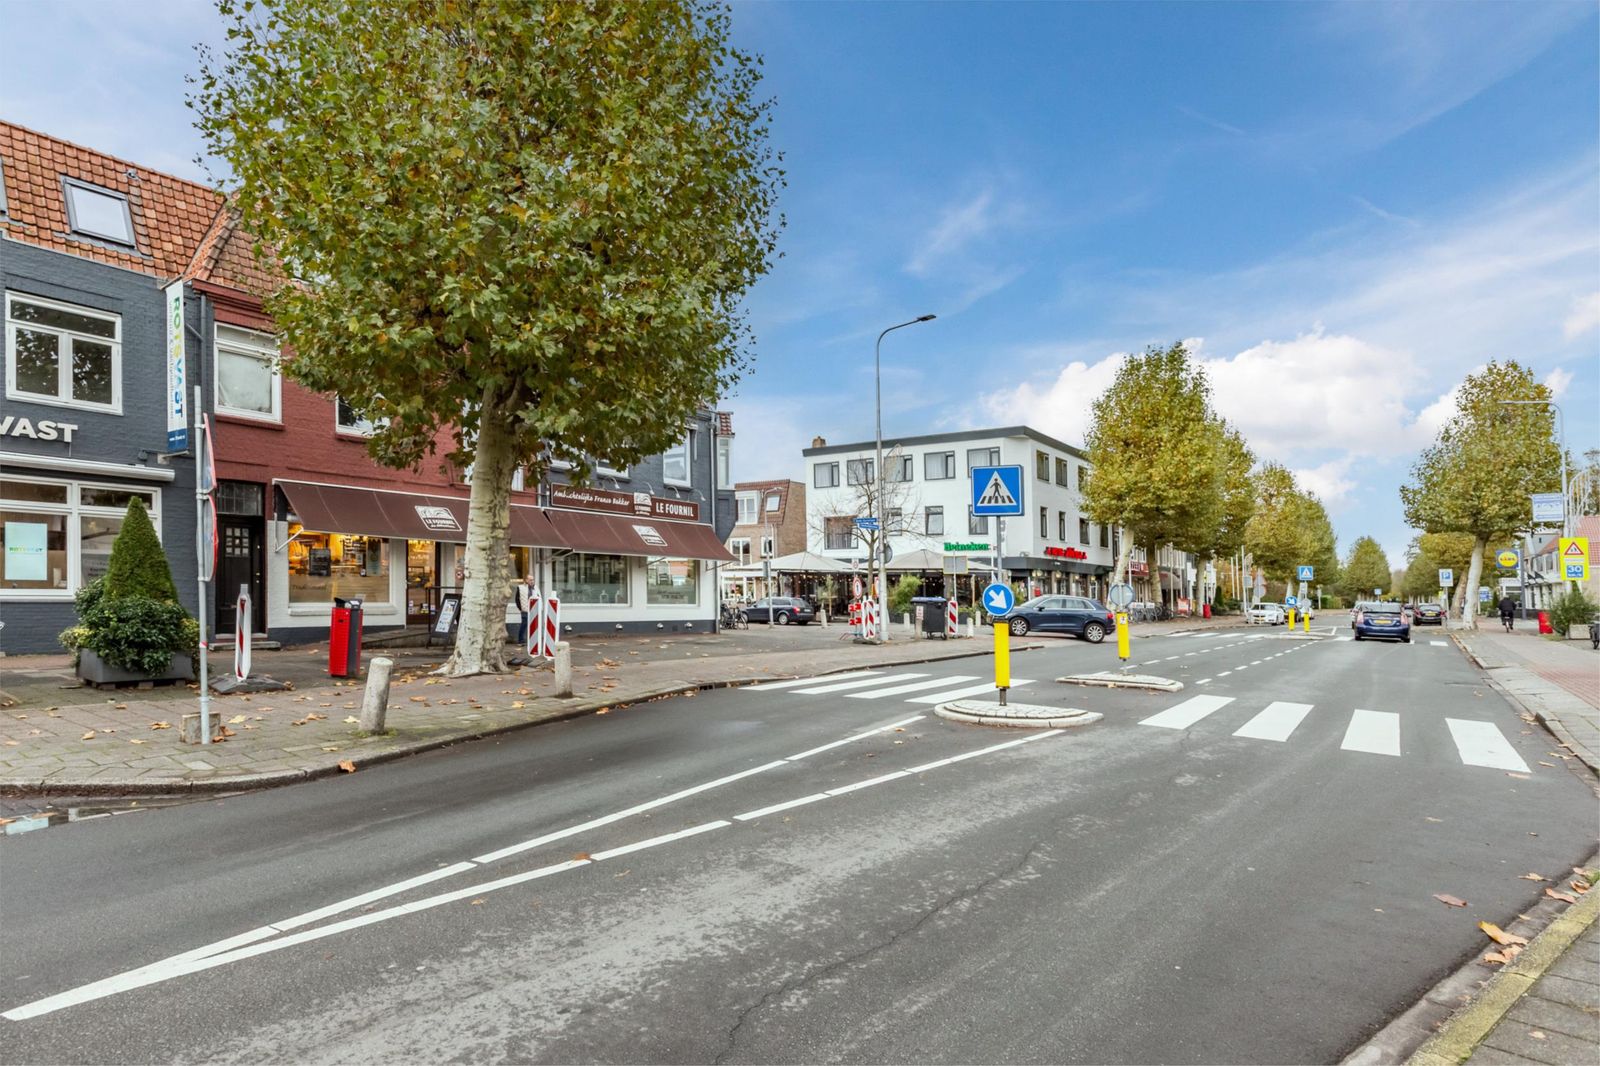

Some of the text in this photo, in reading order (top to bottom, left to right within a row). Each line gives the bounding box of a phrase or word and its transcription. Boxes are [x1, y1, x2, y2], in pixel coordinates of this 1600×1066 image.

[174, 296, 183, 418] ROTSVAST
[0, 416, 78, 443] VAST
[656, 502, 694, 517] LE FOURNIL
[944, 541, 991, 552] Heineken
[1568, 565, 1582, 573] 30
